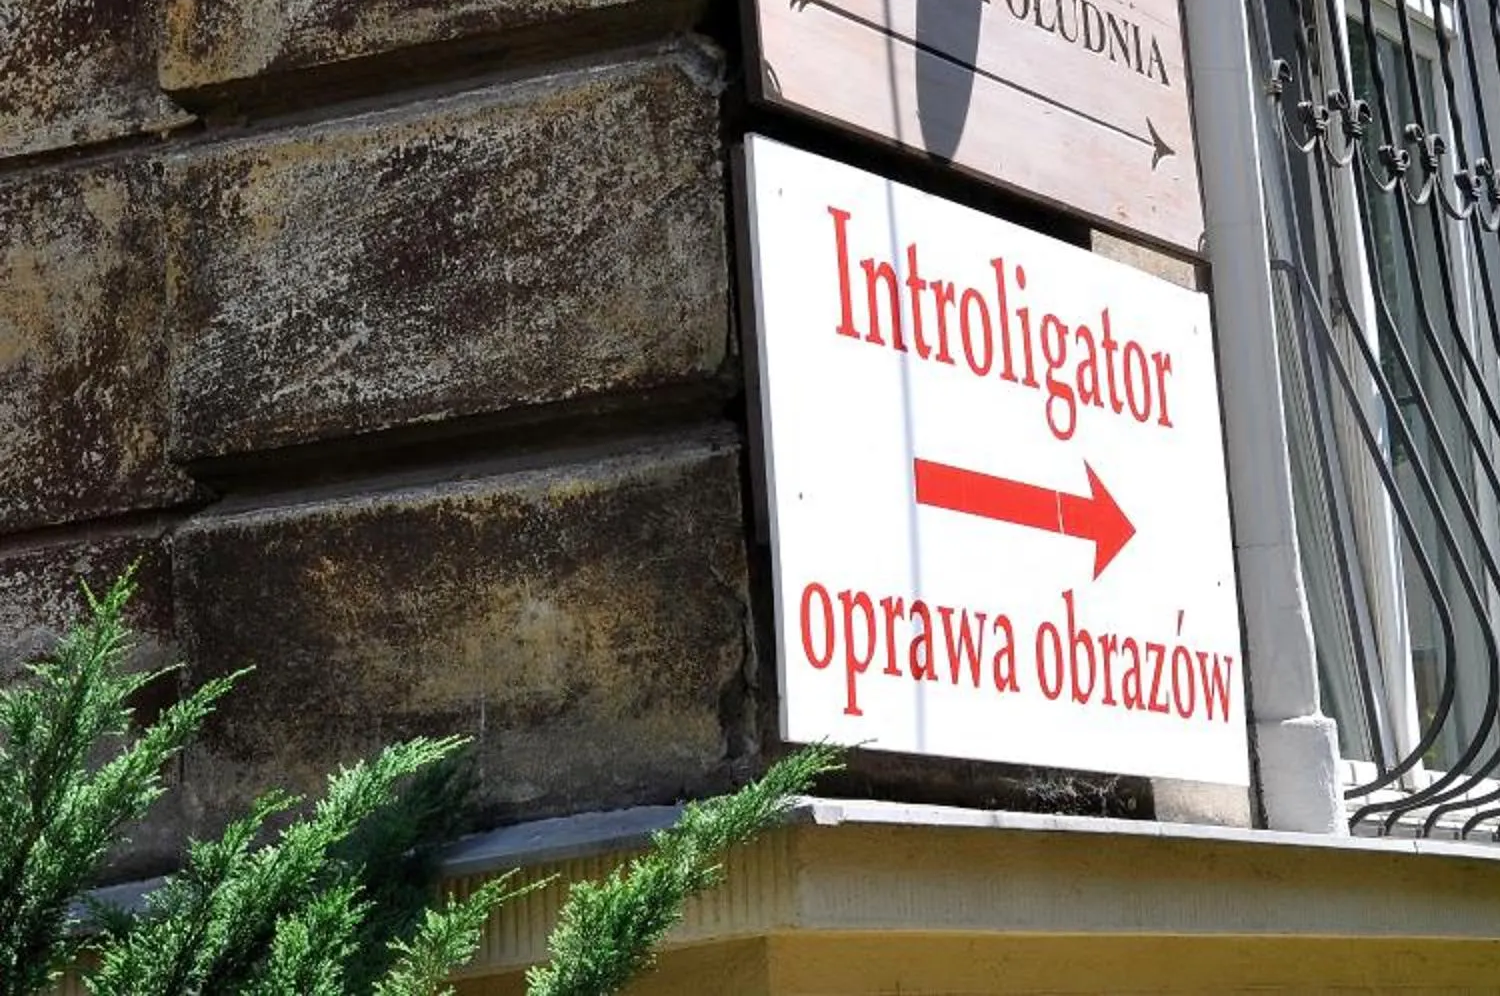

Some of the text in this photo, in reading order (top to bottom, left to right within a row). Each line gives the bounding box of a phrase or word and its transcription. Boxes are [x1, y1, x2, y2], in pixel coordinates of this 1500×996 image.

[827, 204, 1174, 442] Introligator
[800, 580, 1234, 725] oprawa obrazów
